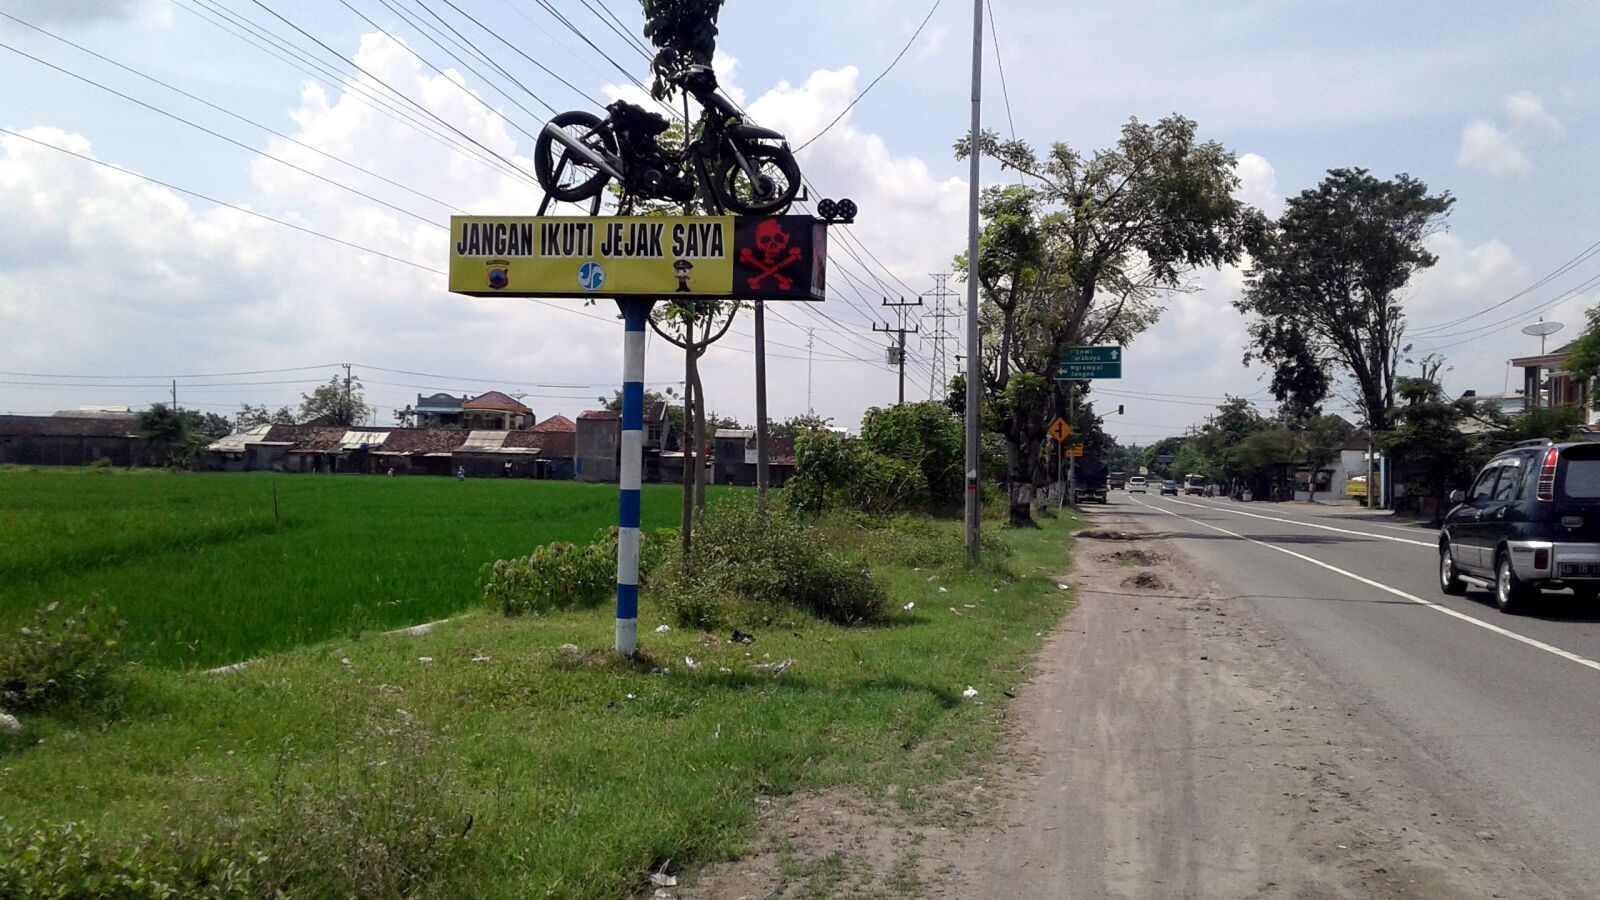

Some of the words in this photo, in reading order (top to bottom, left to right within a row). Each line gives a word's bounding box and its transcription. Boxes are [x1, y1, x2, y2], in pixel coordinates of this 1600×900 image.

[456, 222, 534, 256] JANGAN
[541, 222, 594, 256] IKUTI
[600, 222, 664, 257] JEJAK
[671, 222, 724, 257] SAYA
